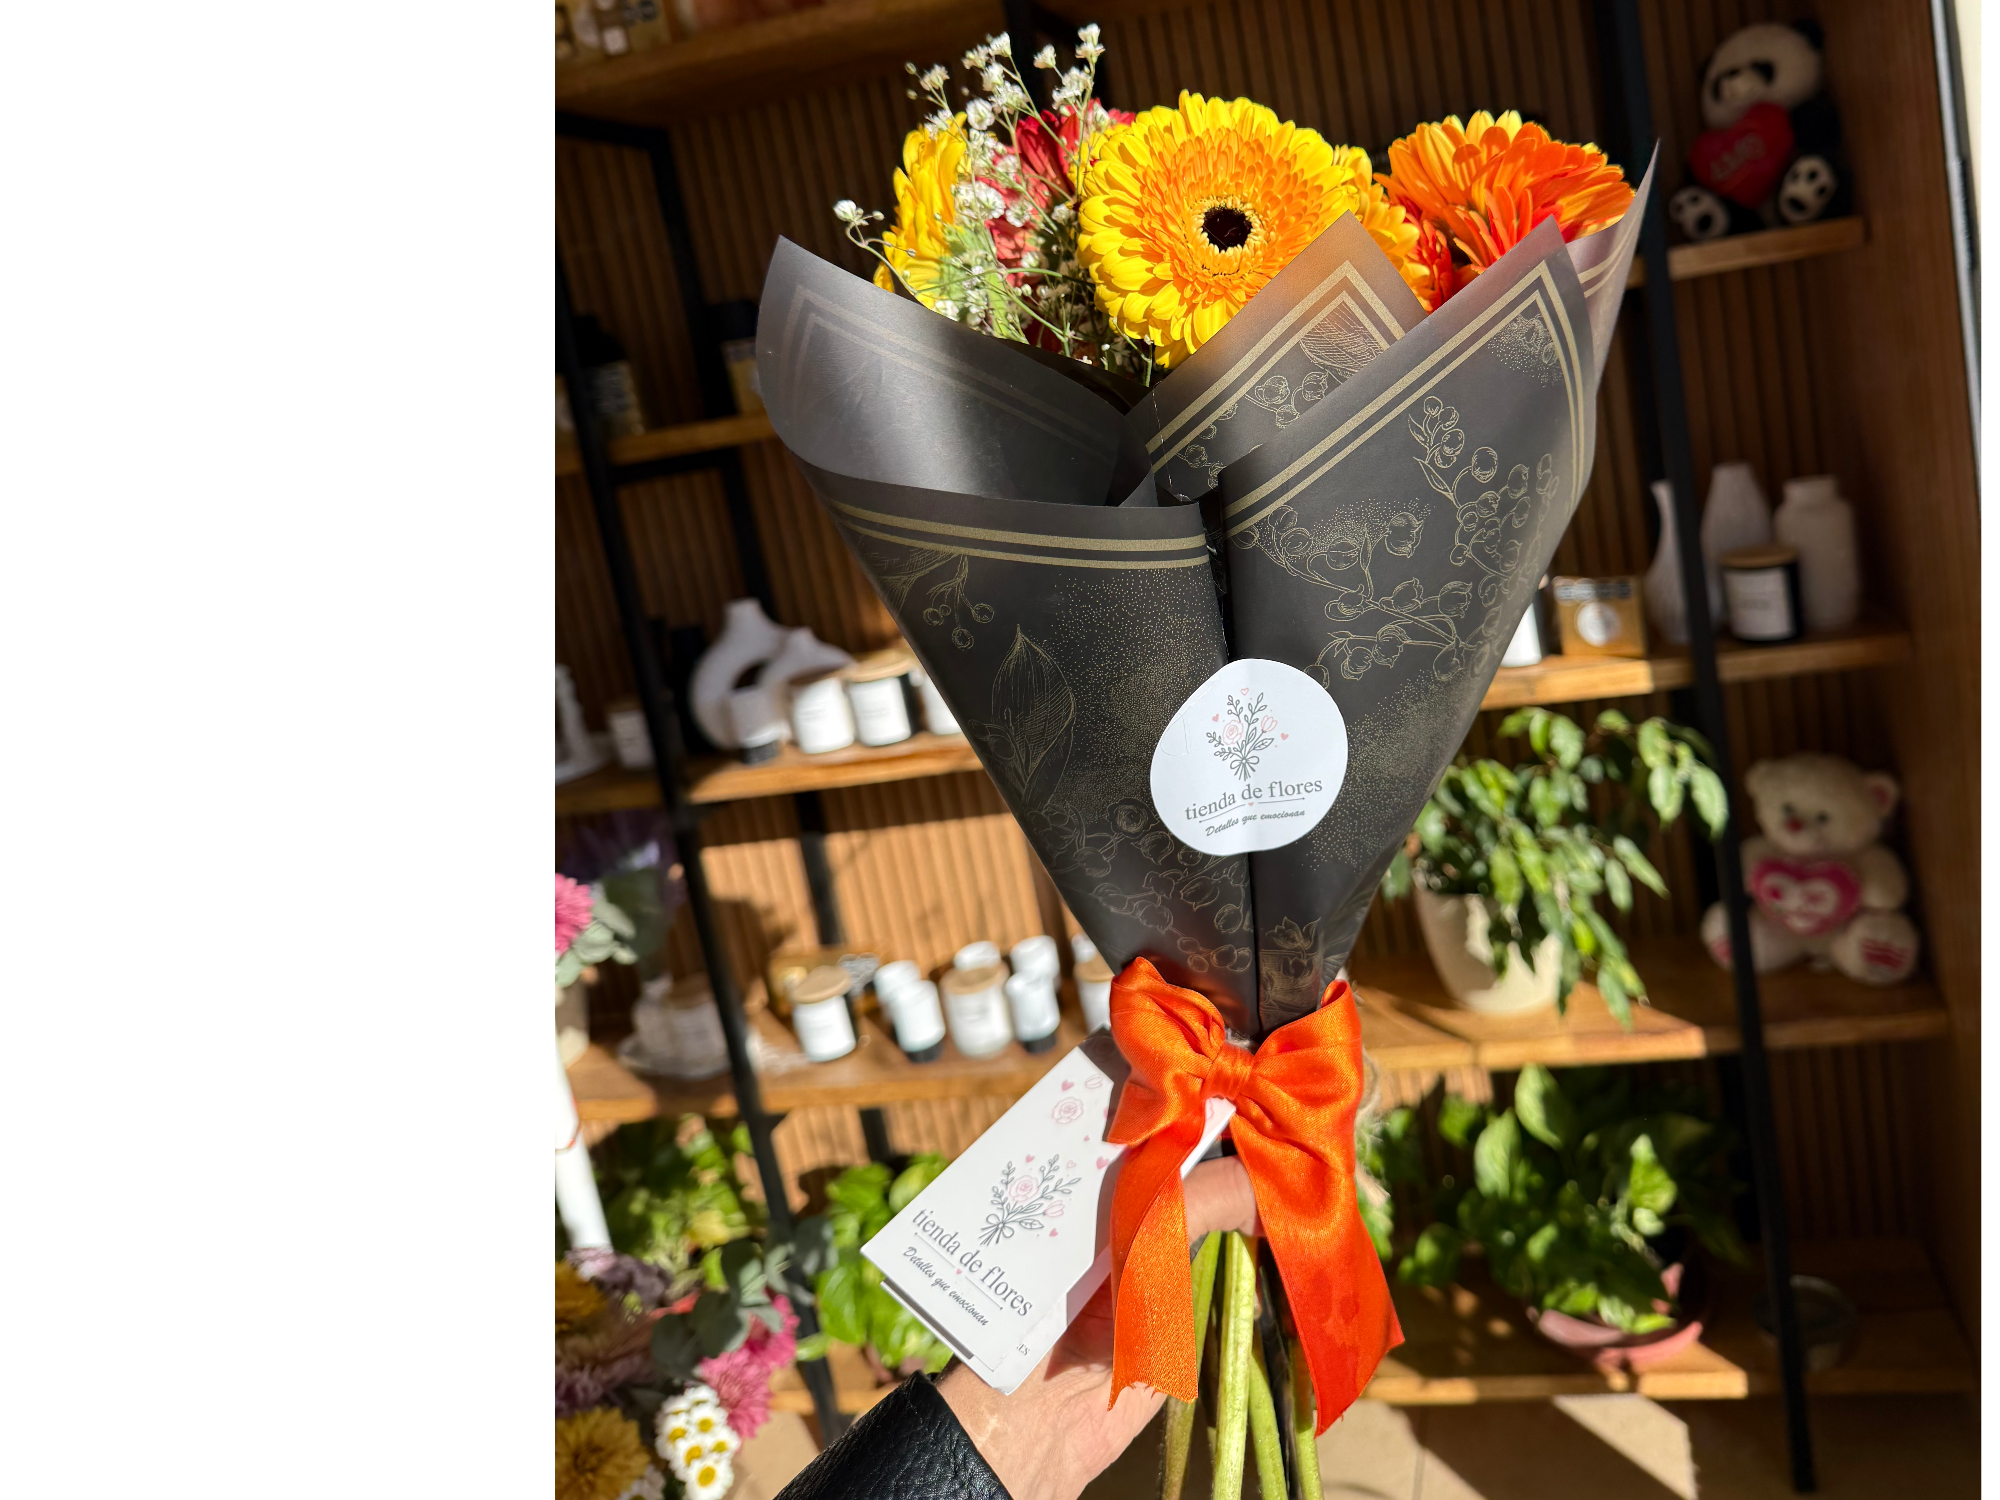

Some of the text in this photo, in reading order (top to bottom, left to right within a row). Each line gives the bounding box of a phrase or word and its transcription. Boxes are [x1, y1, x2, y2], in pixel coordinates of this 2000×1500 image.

[1185, 780, 1323, 820] tienda de flores
[1205, 810, 1305, 836] Detalles que emocionan
[903, 1246, 989, 1326] Detalles que emocionan
[912, 1208, 1033, 1317] tienda de flores
